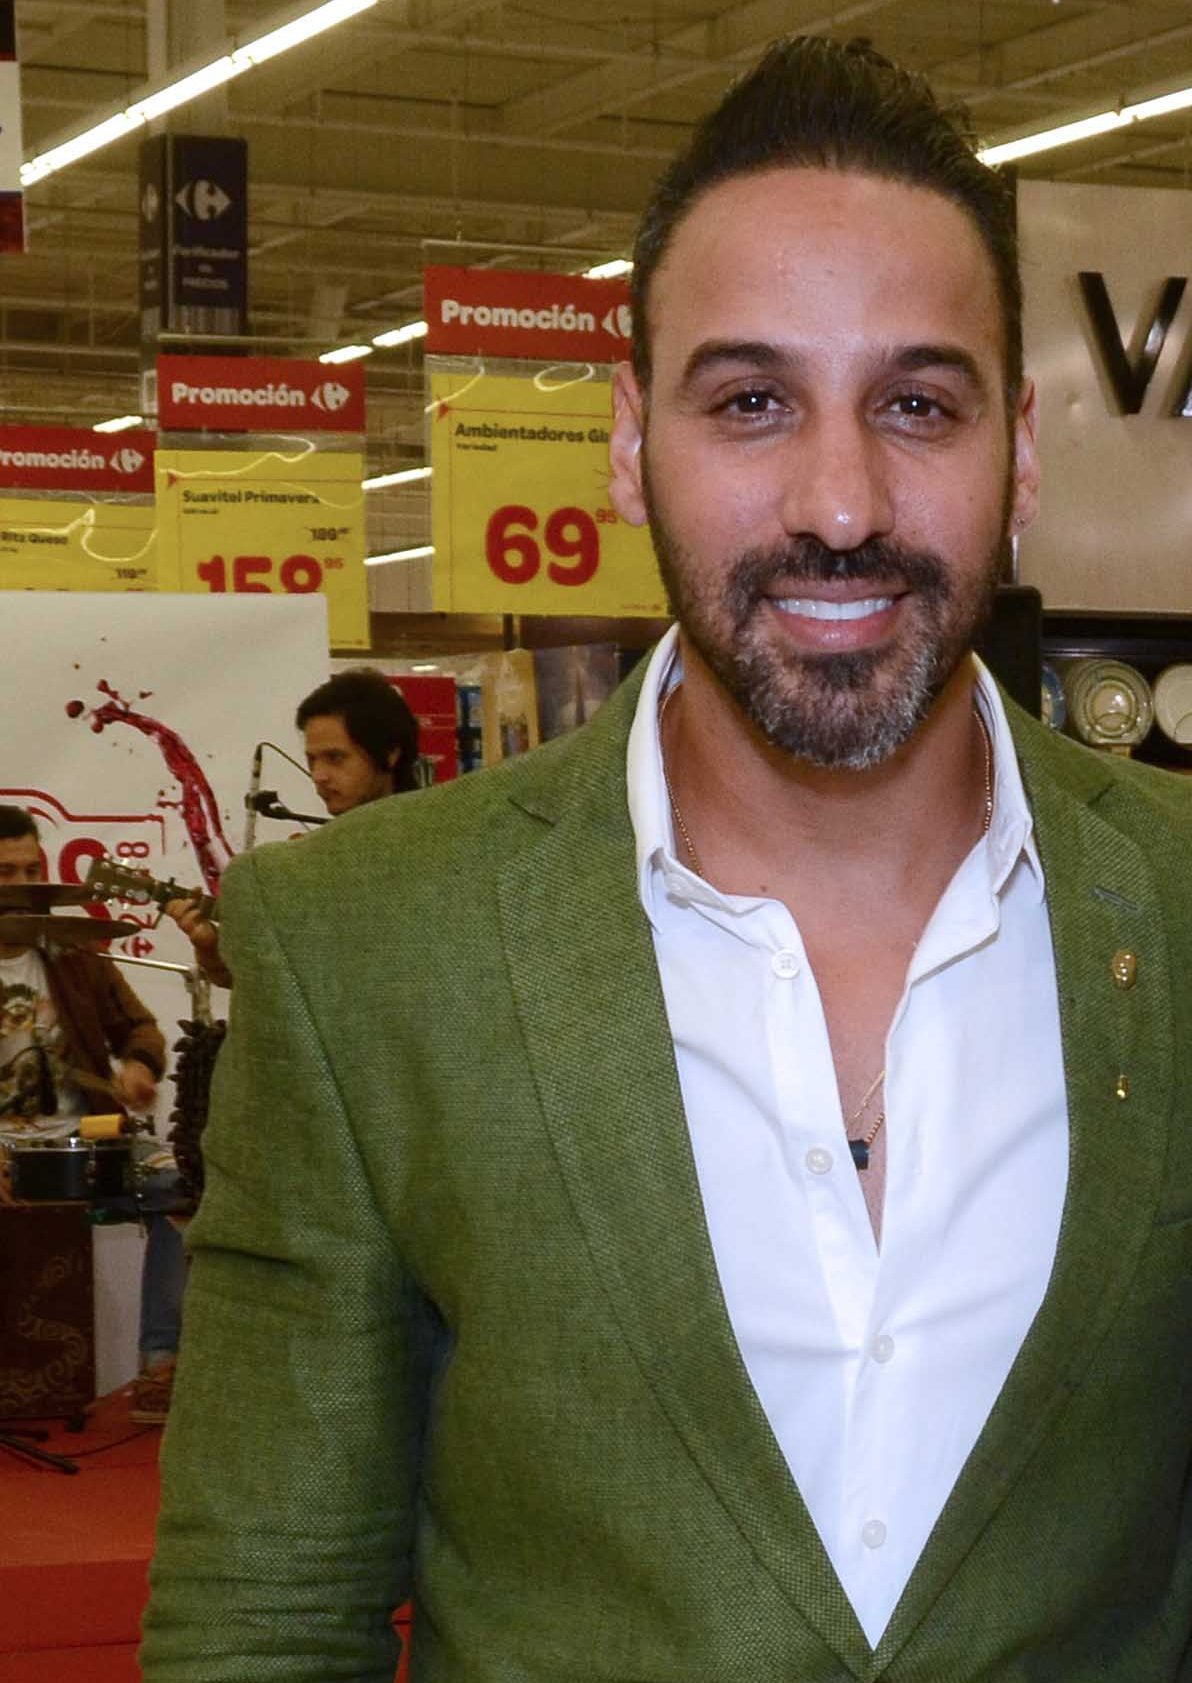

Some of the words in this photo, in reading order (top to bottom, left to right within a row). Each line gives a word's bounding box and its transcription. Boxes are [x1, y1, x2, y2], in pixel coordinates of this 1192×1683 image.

[441, 299, 596, 332] Promoción
[172, 382, 305, 406] Promoción
[455, 422, 584, 443] Ambientadores
[0, 449, 105, 469] romoción
[183, 490, 241, 503] Suavitel
[485, 505, 600, 587] 69
